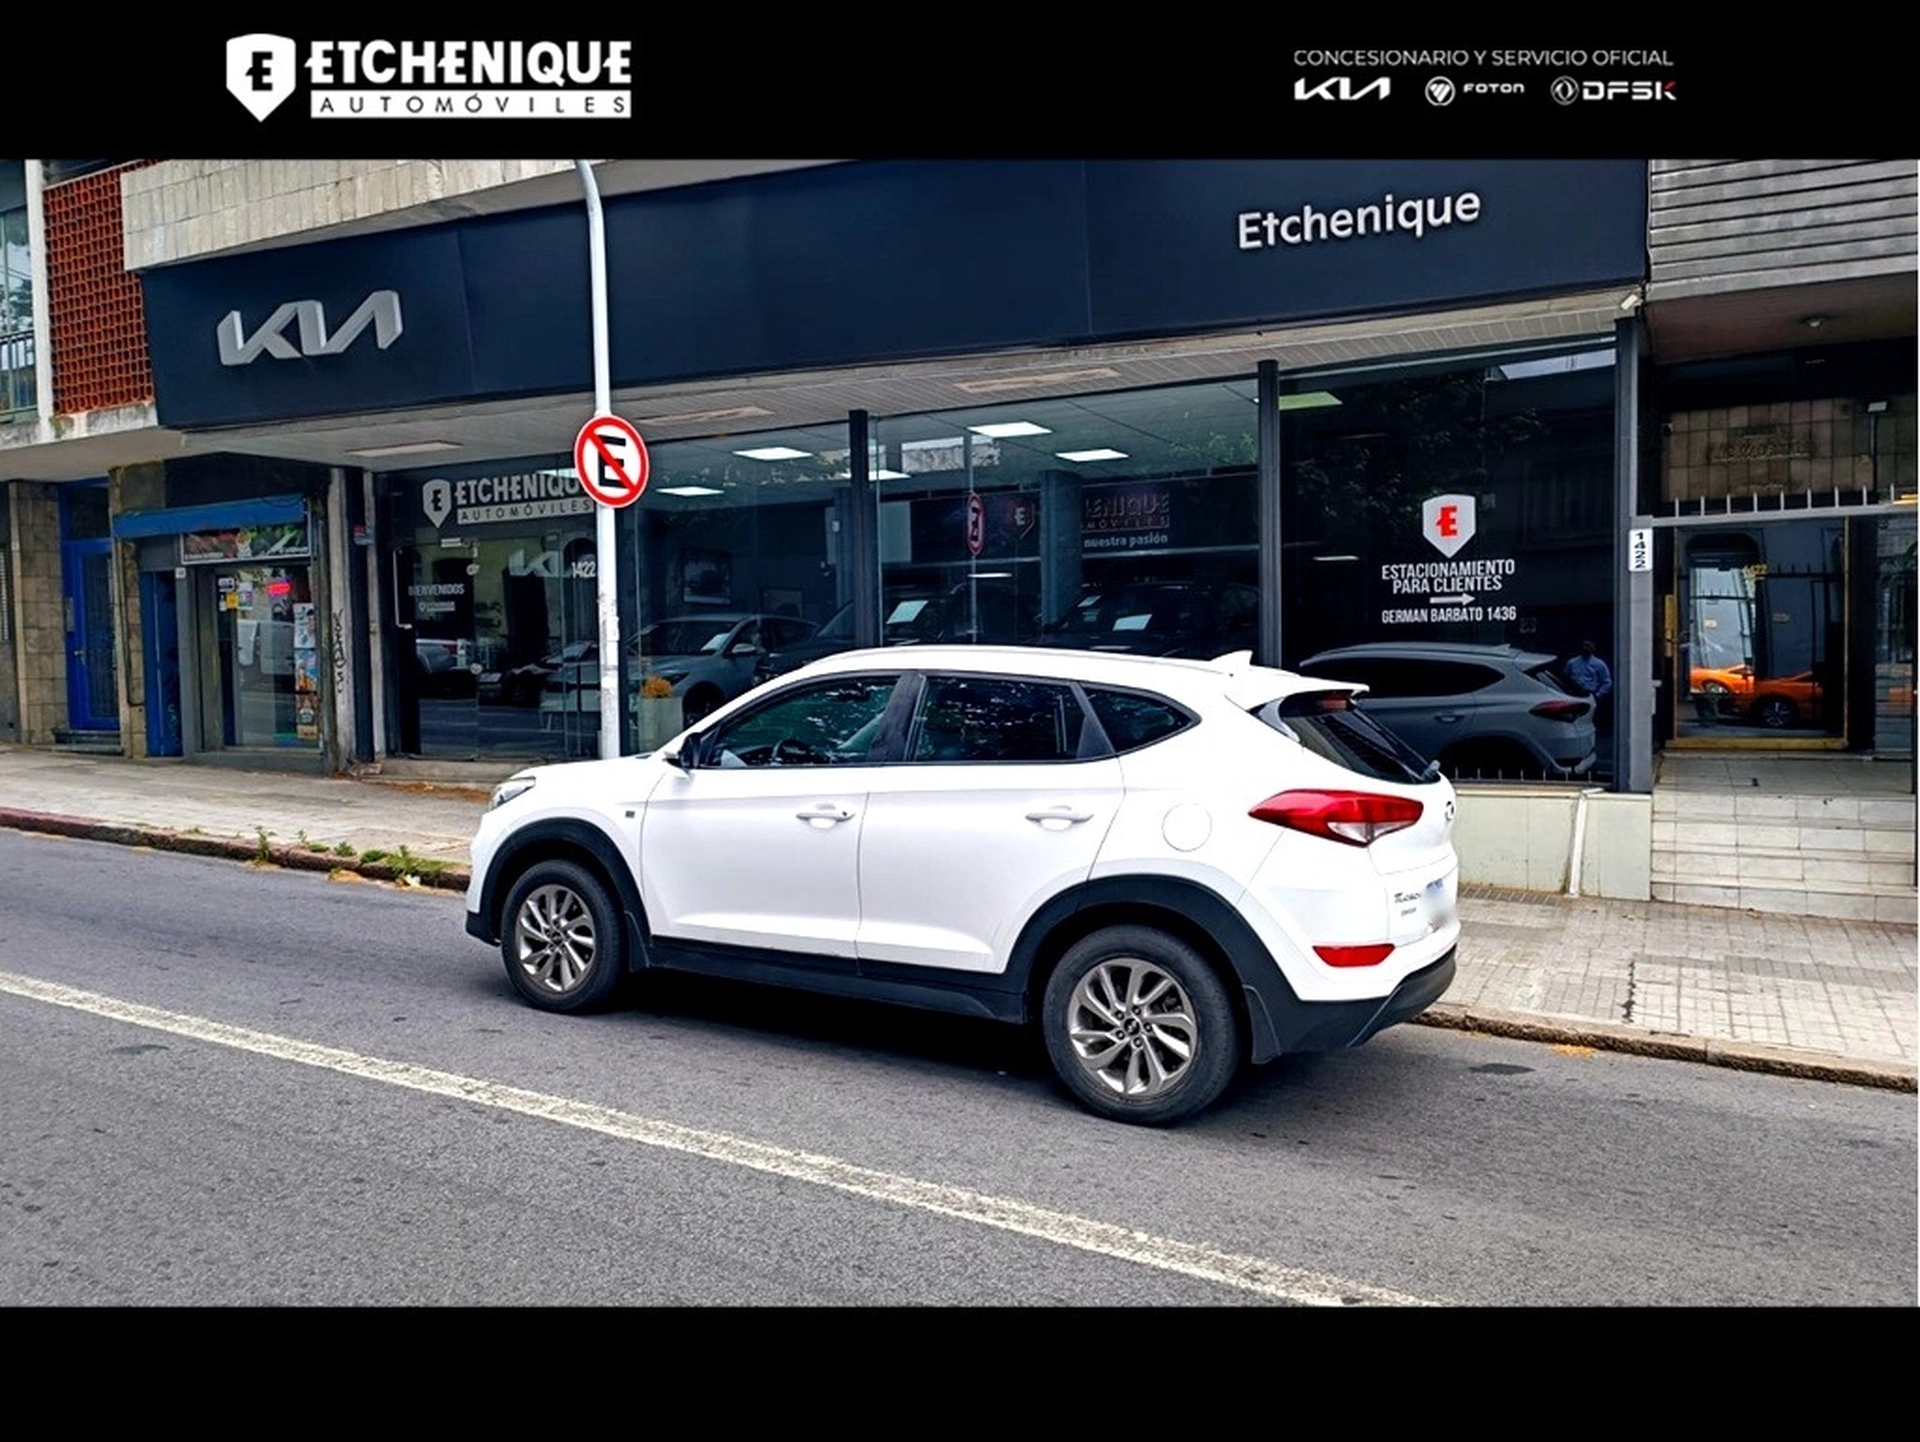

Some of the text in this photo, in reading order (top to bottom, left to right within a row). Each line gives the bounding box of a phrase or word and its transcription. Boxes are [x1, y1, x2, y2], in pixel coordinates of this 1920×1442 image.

[1238, 191, 1481, 249] Etchenique
[454, 473, 582, 505] ETCHENIQU
[461, 500, 591, 521] AUTOMÓVILES
[1084, 536, 1127, 548] nuestra
[1634, 531, 1646, 569] 1422
[571, 560, 596, 578] 1422
[1381, 558, 1516, 580] ESTACIONAMIENTO
[1393, 574, 1503, 594] PARA CLIENTES
[1381, 606, 1517, 624] GERMAN BARBATO 1436
